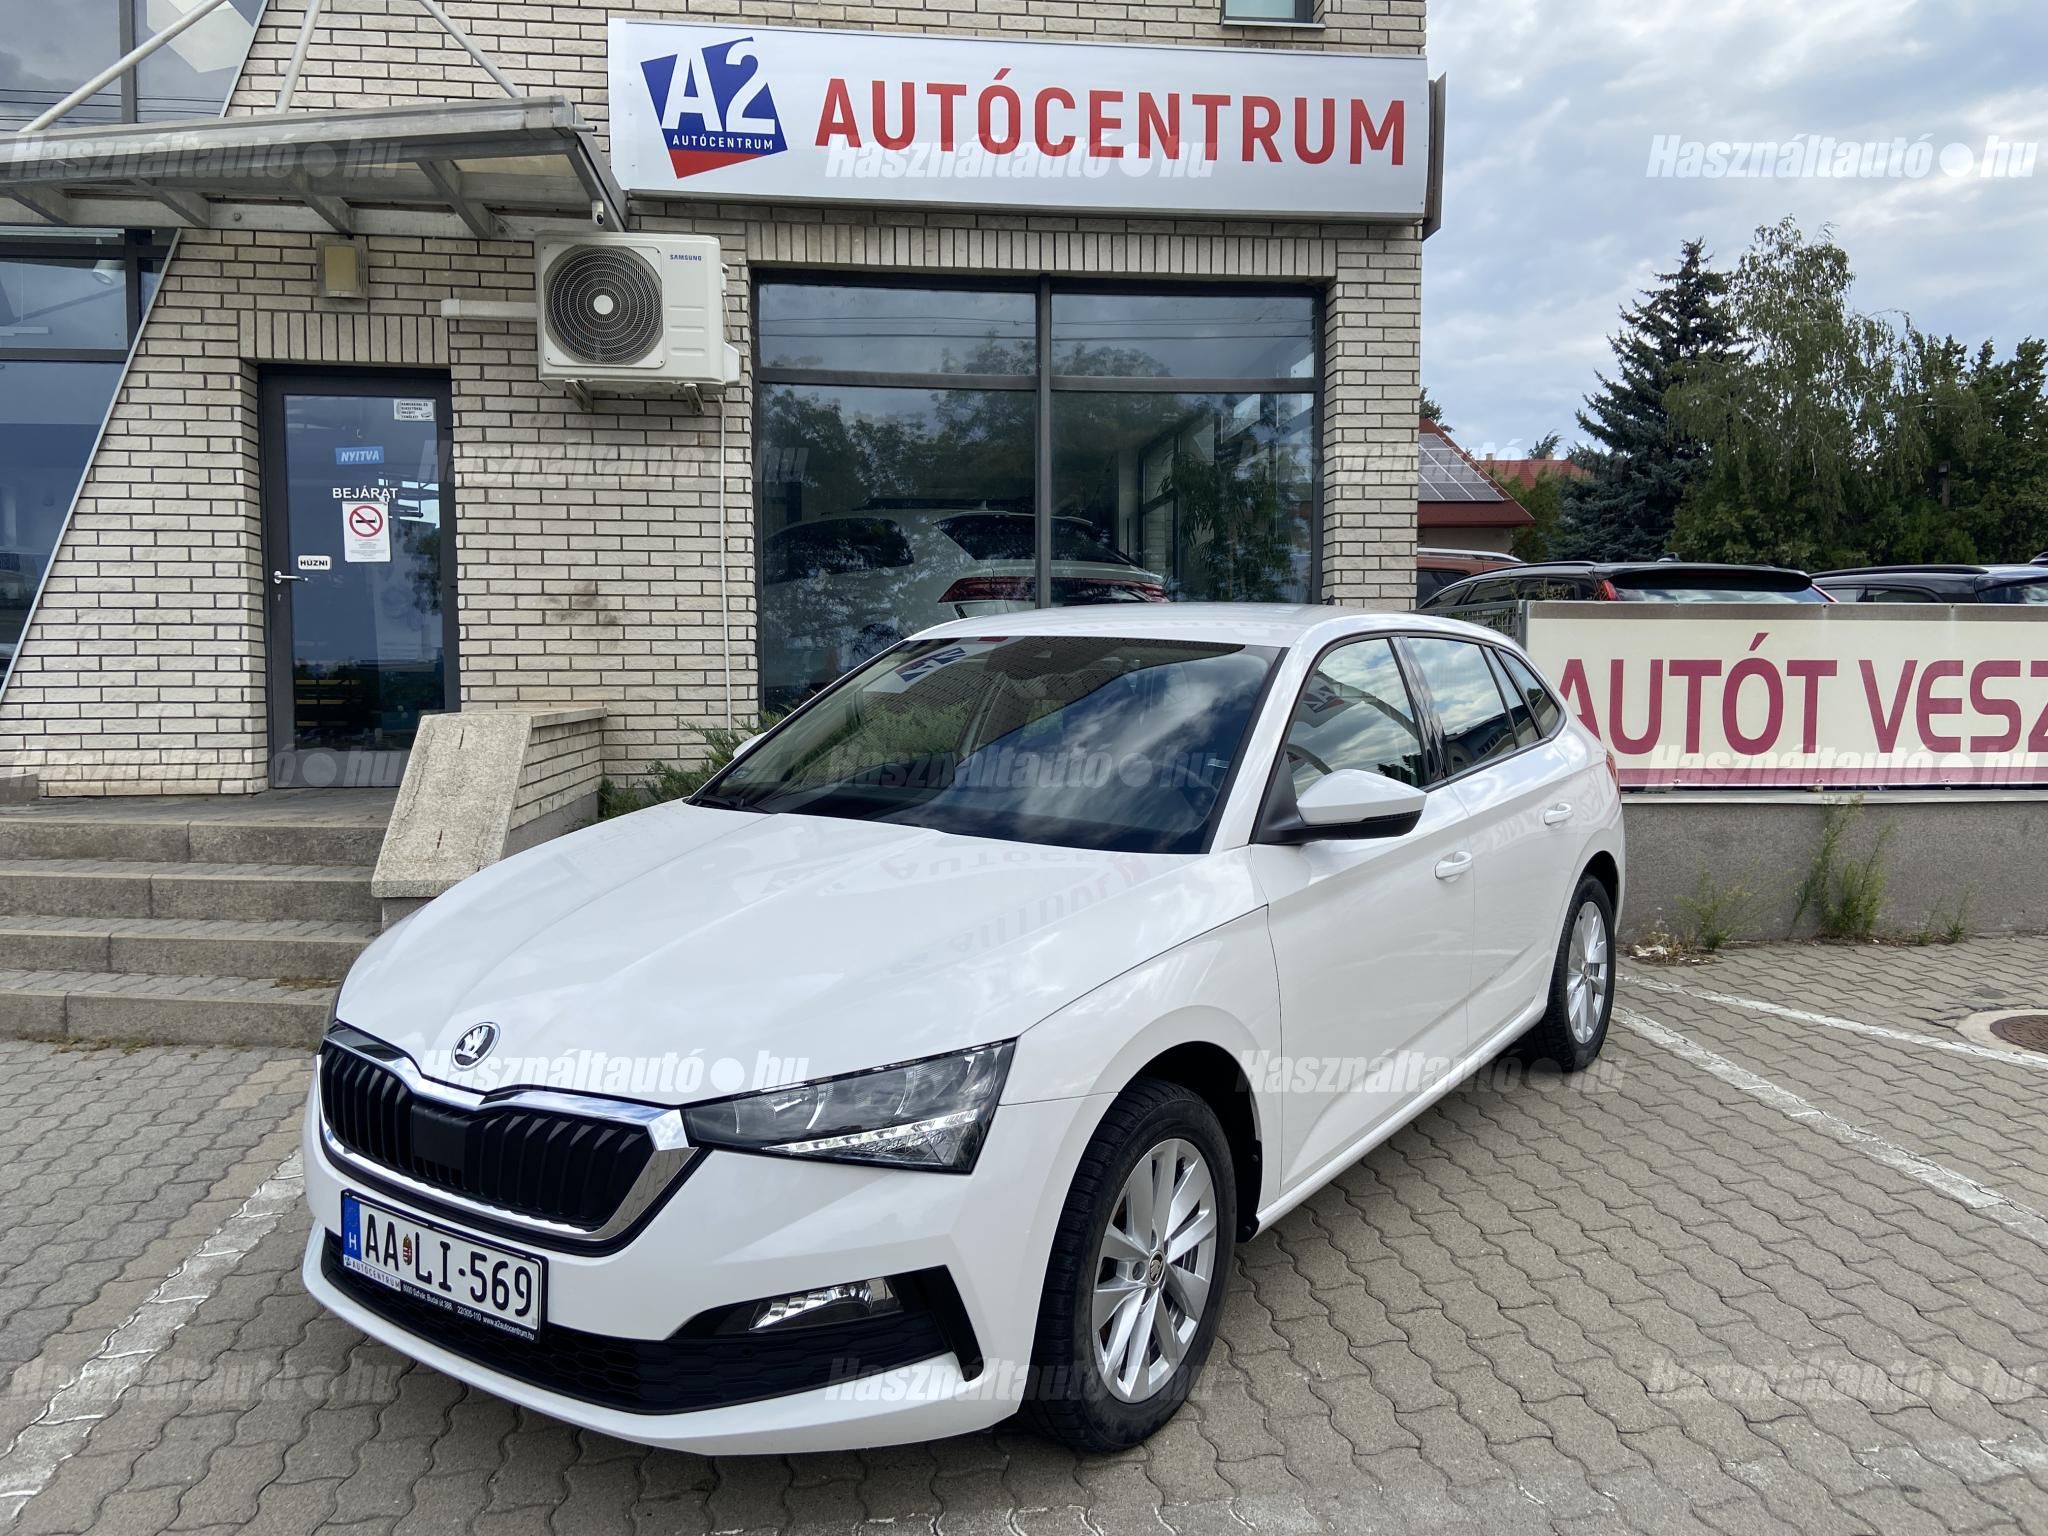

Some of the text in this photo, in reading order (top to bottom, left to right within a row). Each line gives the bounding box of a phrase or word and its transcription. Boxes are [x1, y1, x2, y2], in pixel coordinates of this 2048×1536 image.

[661, 40, 775, 135] A2
[816, 68, 1404, 166] AUTÓCENTRUM
[672, 135, 773, 150] AUTÓCENTRUM
[340, 450, 380, 462] NYITVA
[332, 485, 399, 499] BEJÁRAT
[1559, 632, 1837, 755] AUTÓT
[348, 1231, 358, 1251] H
